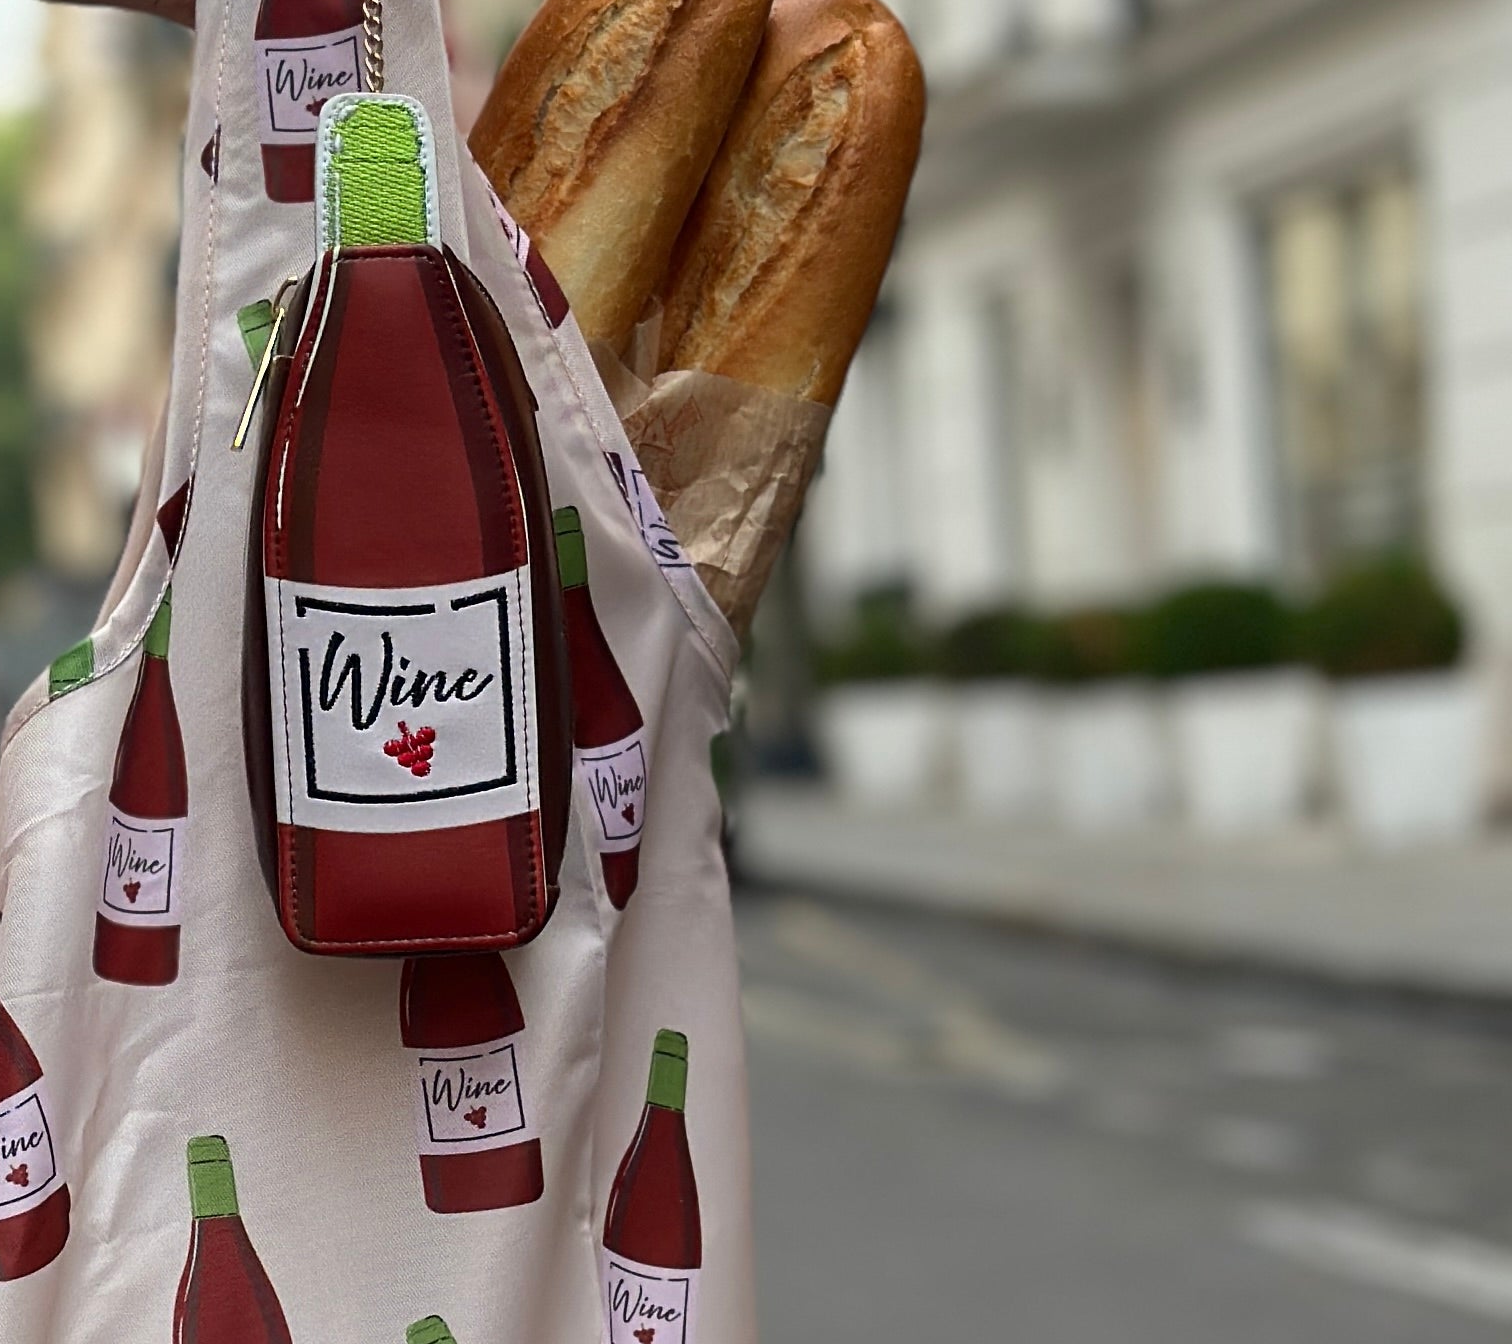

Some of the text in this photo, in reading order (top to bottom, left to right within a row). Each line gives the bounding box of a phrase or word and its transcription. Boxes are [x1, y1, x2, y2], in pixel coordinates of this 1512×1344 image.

[276, 58, 354, 102] Wine
[319, 632, 493, 731] Wine
[595, 766, 644, 809] Wine
[111, 834, 166, 876] Wine
[432, 1069, 512, 1111] Wine
[613, 1278, 680, 1322] Wine
